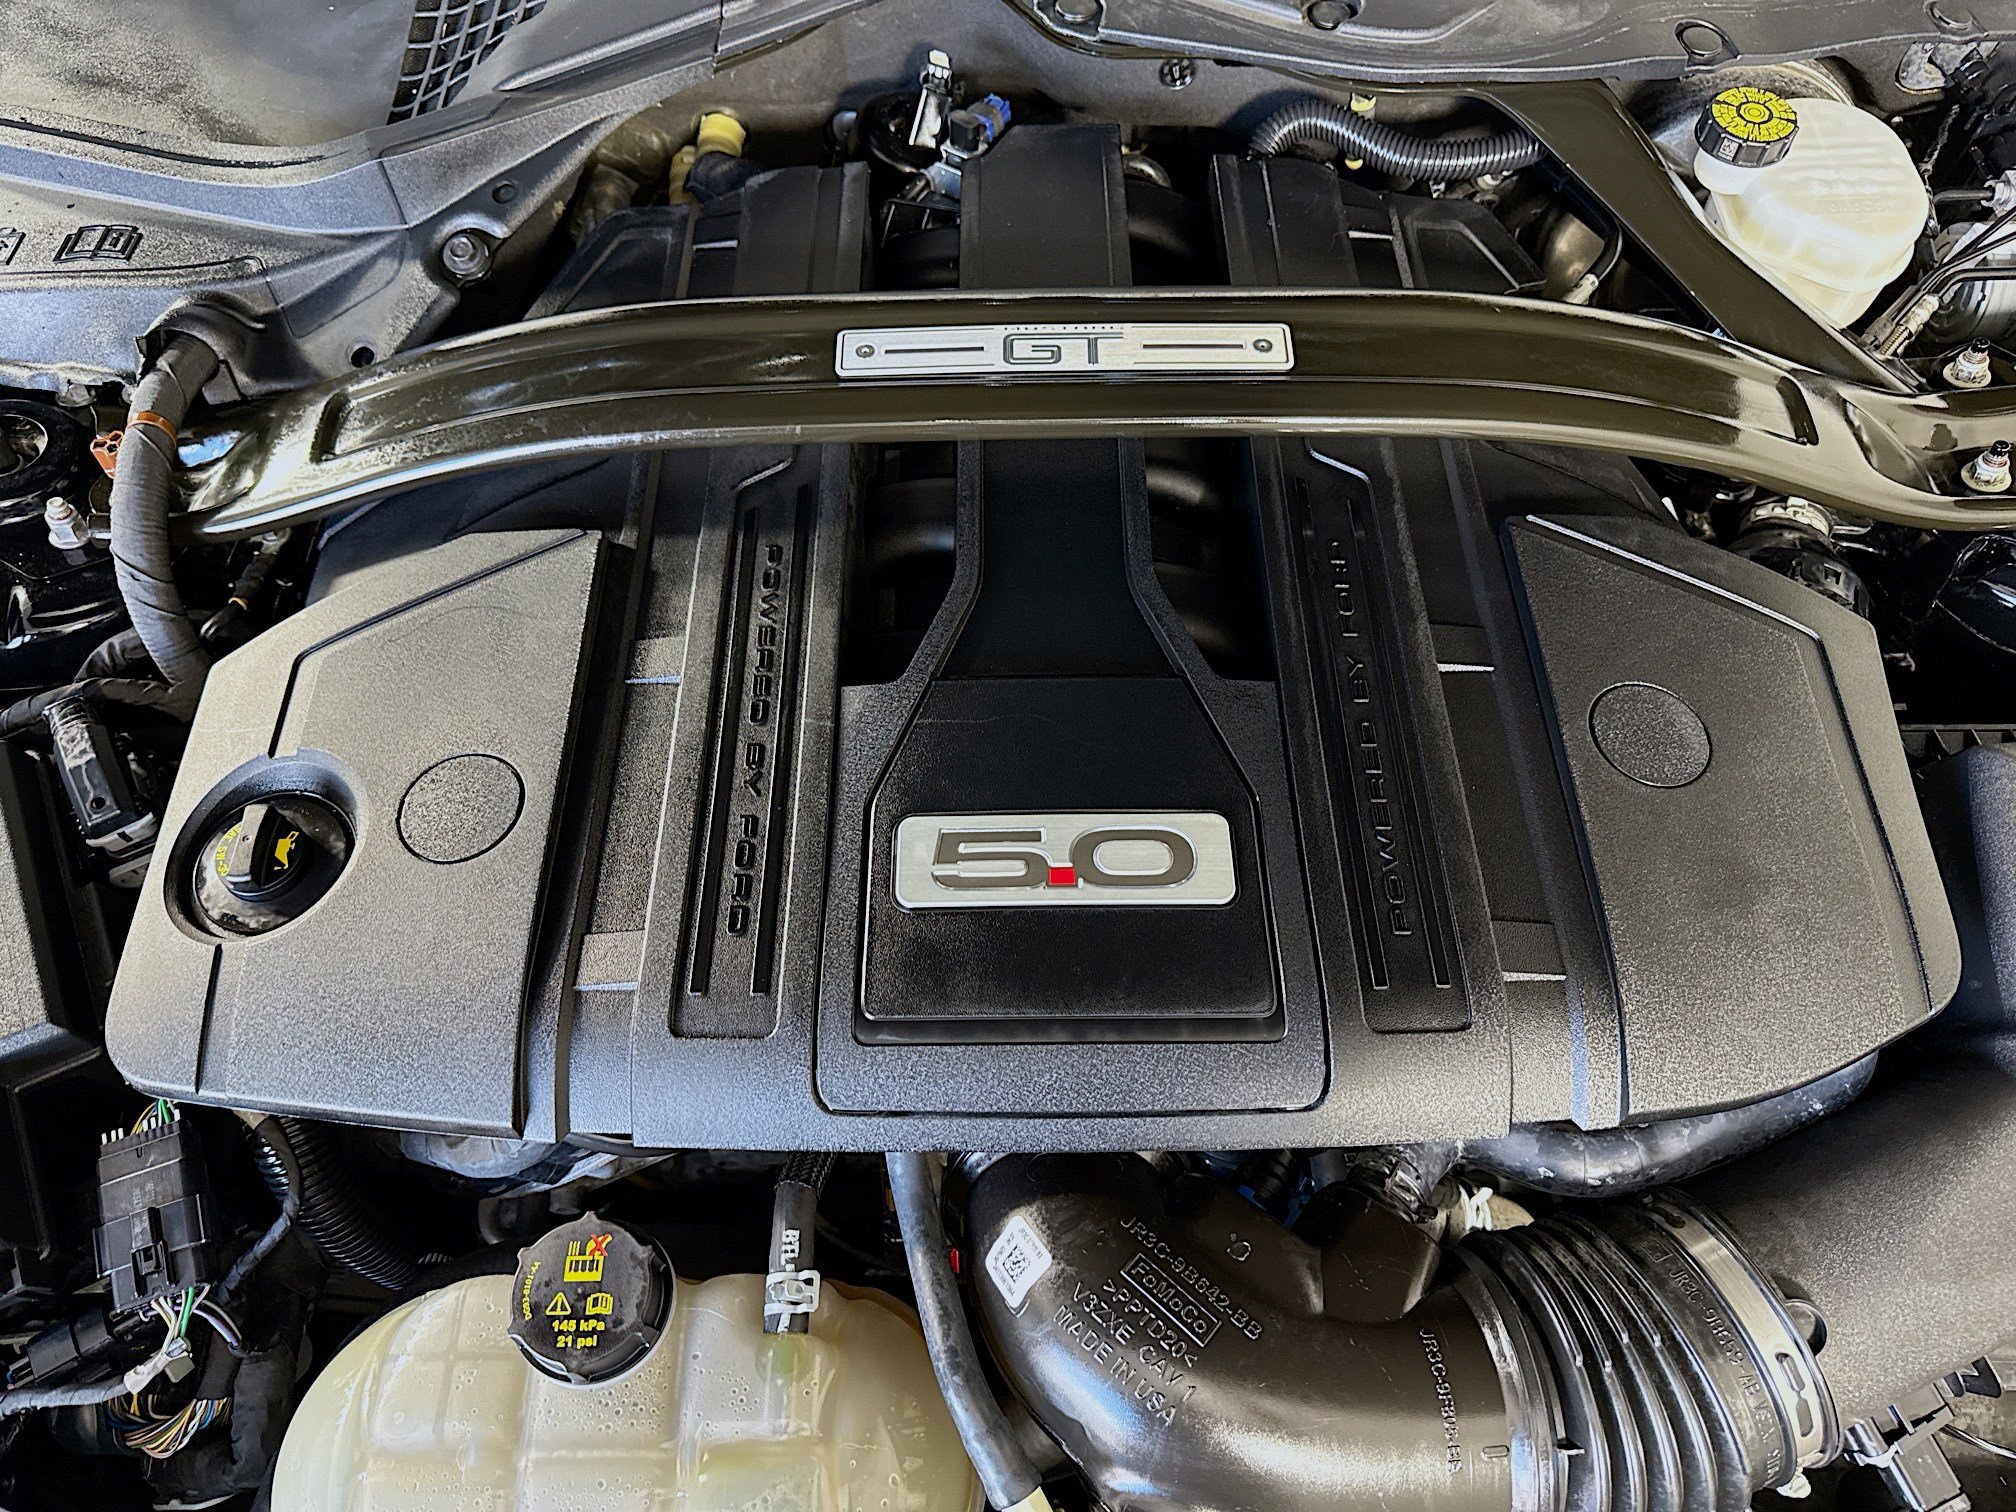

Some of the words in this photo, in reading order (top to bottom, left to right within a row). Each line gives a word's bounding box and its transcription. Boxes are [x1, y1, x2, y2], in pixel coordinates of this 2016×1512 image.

[1003, 331, 1124, 366] GT
[749, 544, 784, 726] POWERED
[1346, 655, 1370, 703] BY
[742, 742, 767, 798] BY
[931, 826, 1198, 891] 5.0
[1358, 720, 1412, 936] POWERED
[727, 814, 760, 936] FORD
[1120, 1215, 1264, 1341] JR3C-9B642-BB
[1130, 1261, 1209, 1335] FoMoCo
[551, 1319, 577, 1332] 145
[579, 1319, 606, 1331] kPa
[556, 1335, 573, 1348] 21
[576, 1335, 598, 1349] psi
[1053, 1304, 1113, 1365] MADE
[1109, 1356, 1137, 1386] IN
[1134, 1378, 1177, 1427] USA
[1138, 1345, 1184, 1387] CAV
